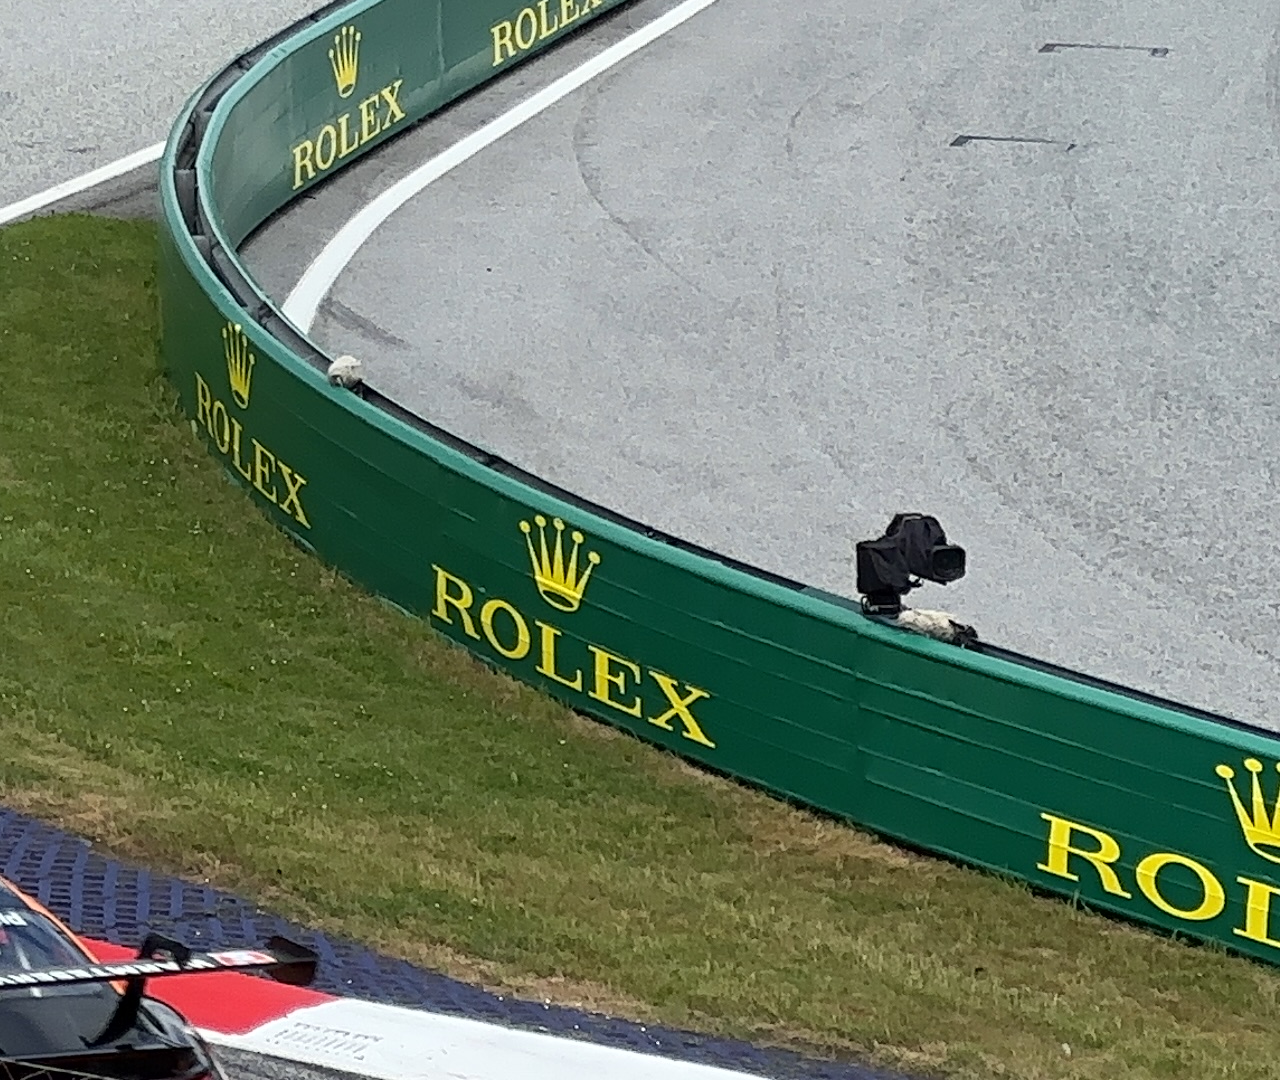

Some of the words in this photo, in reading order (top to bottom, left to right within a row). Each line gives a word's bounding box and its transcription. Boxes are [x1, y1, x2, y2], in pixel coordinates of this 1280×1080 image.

[292, 80, 406, 190] ROLEX
[194, 372, 312, 530] ROLEX
[431, 563, 716, 749] ROLEX
